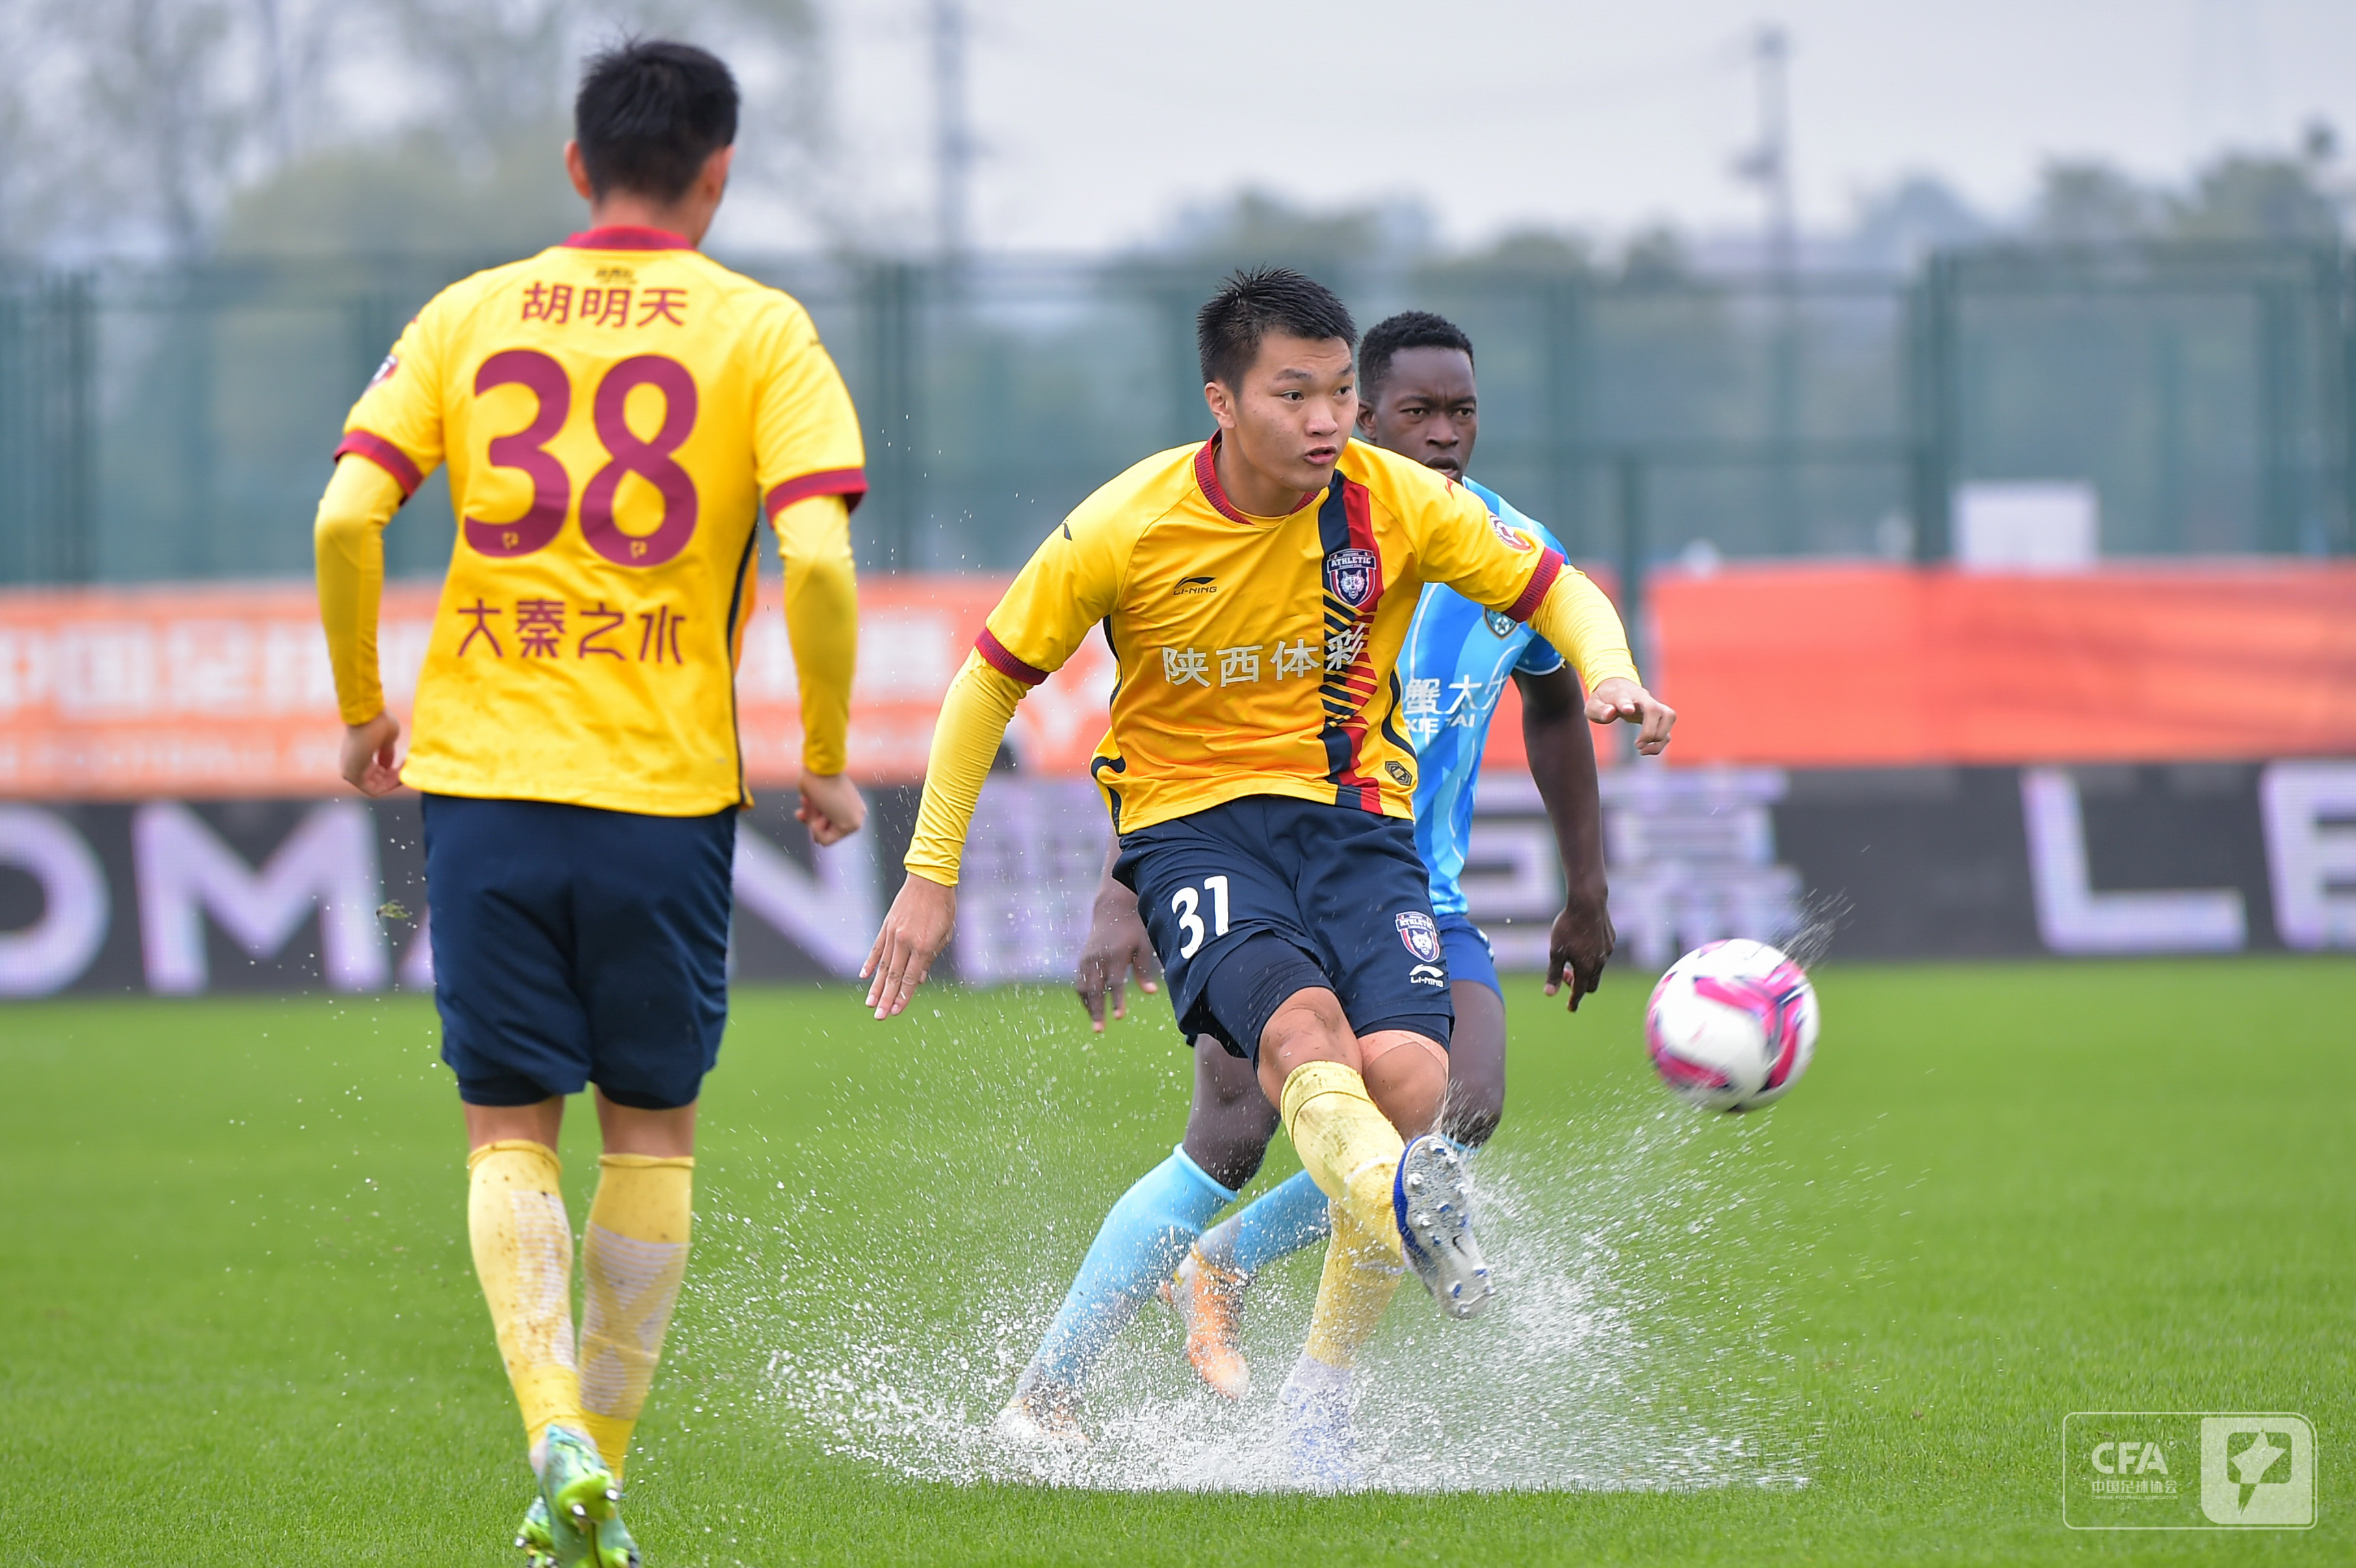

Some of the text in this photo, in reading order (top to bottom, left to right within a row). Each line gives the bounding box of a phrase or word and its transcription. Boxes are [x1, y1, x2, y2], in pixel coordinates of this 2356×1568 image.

[521, 282, 688, 327] 胡明天
[464, 348, 699, 568] 38
[1173, 586, 1217, 595] LI-NING
[1331, 556, 1371, 567] ATHLETIC
[456, 598, 687, 665] 大秦之水
[1162, 622, 1366, 688] 陕西体彩
[1171, 875, 1229, 960] 31
